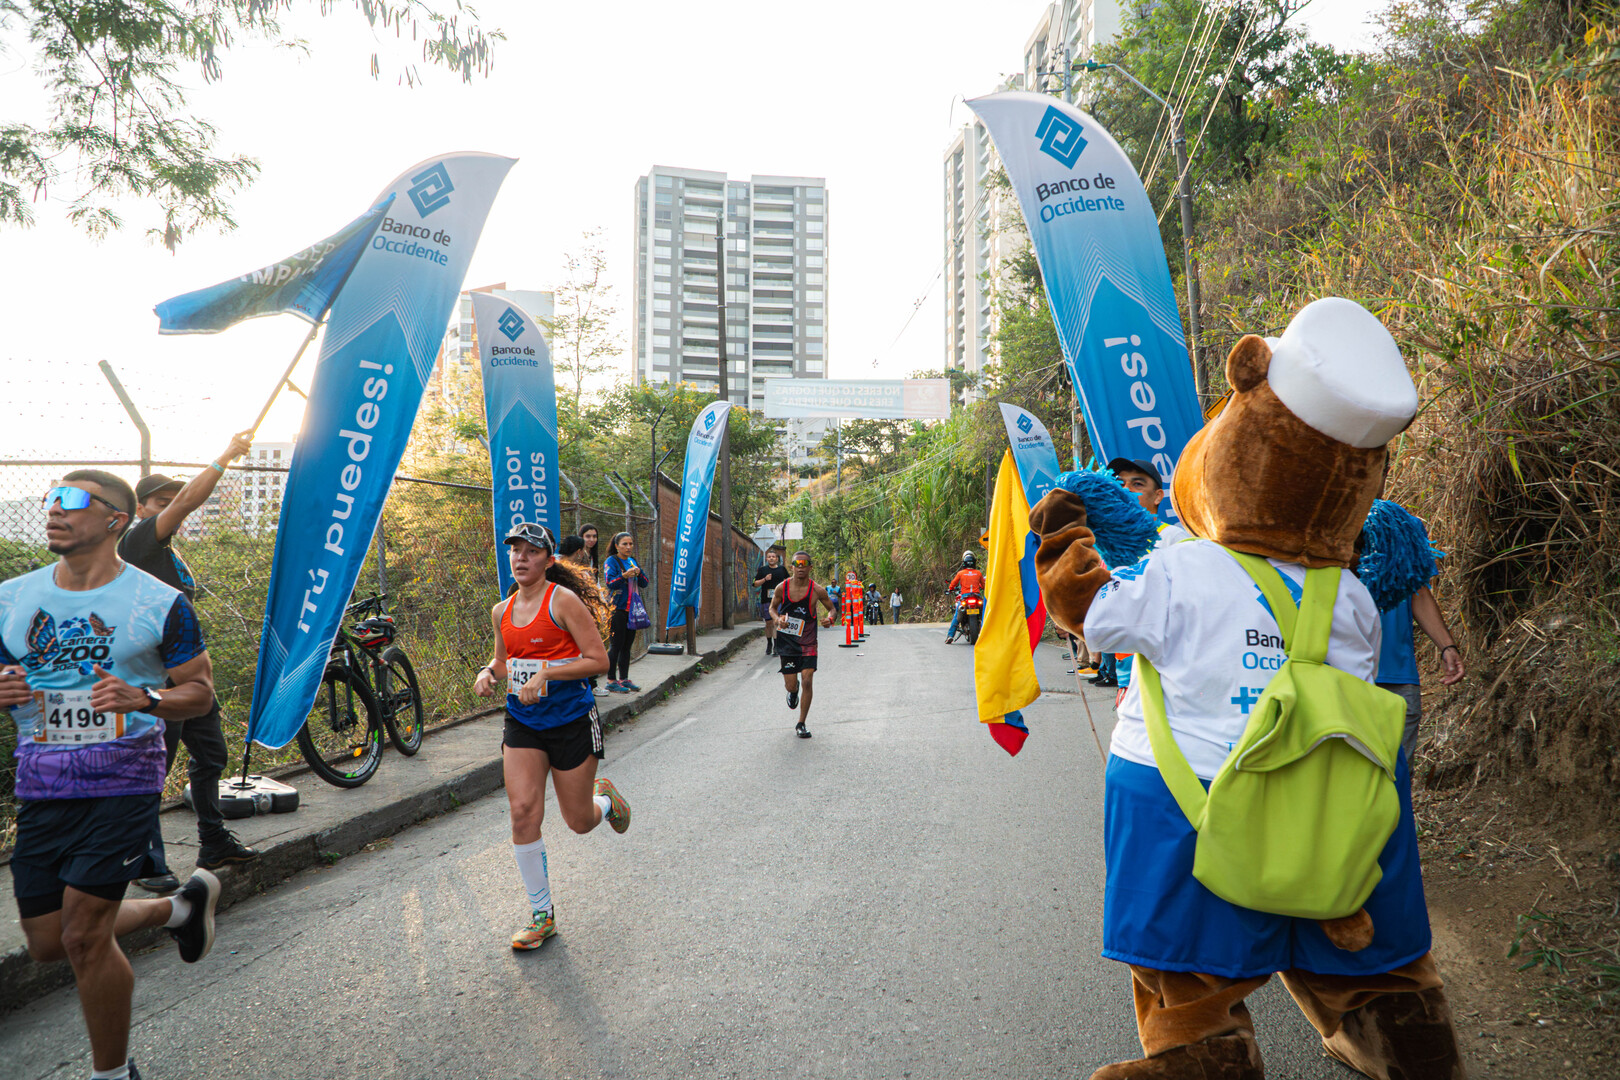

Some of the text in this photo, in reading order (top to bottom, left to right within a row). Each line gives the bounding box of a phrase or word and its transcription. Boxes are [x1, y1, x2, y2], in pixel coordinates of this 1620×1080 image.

[1036, 173, 1116, 202] Banco de
[1040, 195, 1125, 223] Occidente
[381, 217, 451, 247] Banco de
[372, 235, 448, 267] Occidente
[490, 356, 539, 367] Occidente
[491, 346, 536, 356] Banco de
[324, 360, 394, 556] puedes!
[505, 446, 529, 491] por
[679, 481, 699, 543] fuerte!
[52, 661, 80, 673] 2025
[49, 708, 106, 728] 4196
